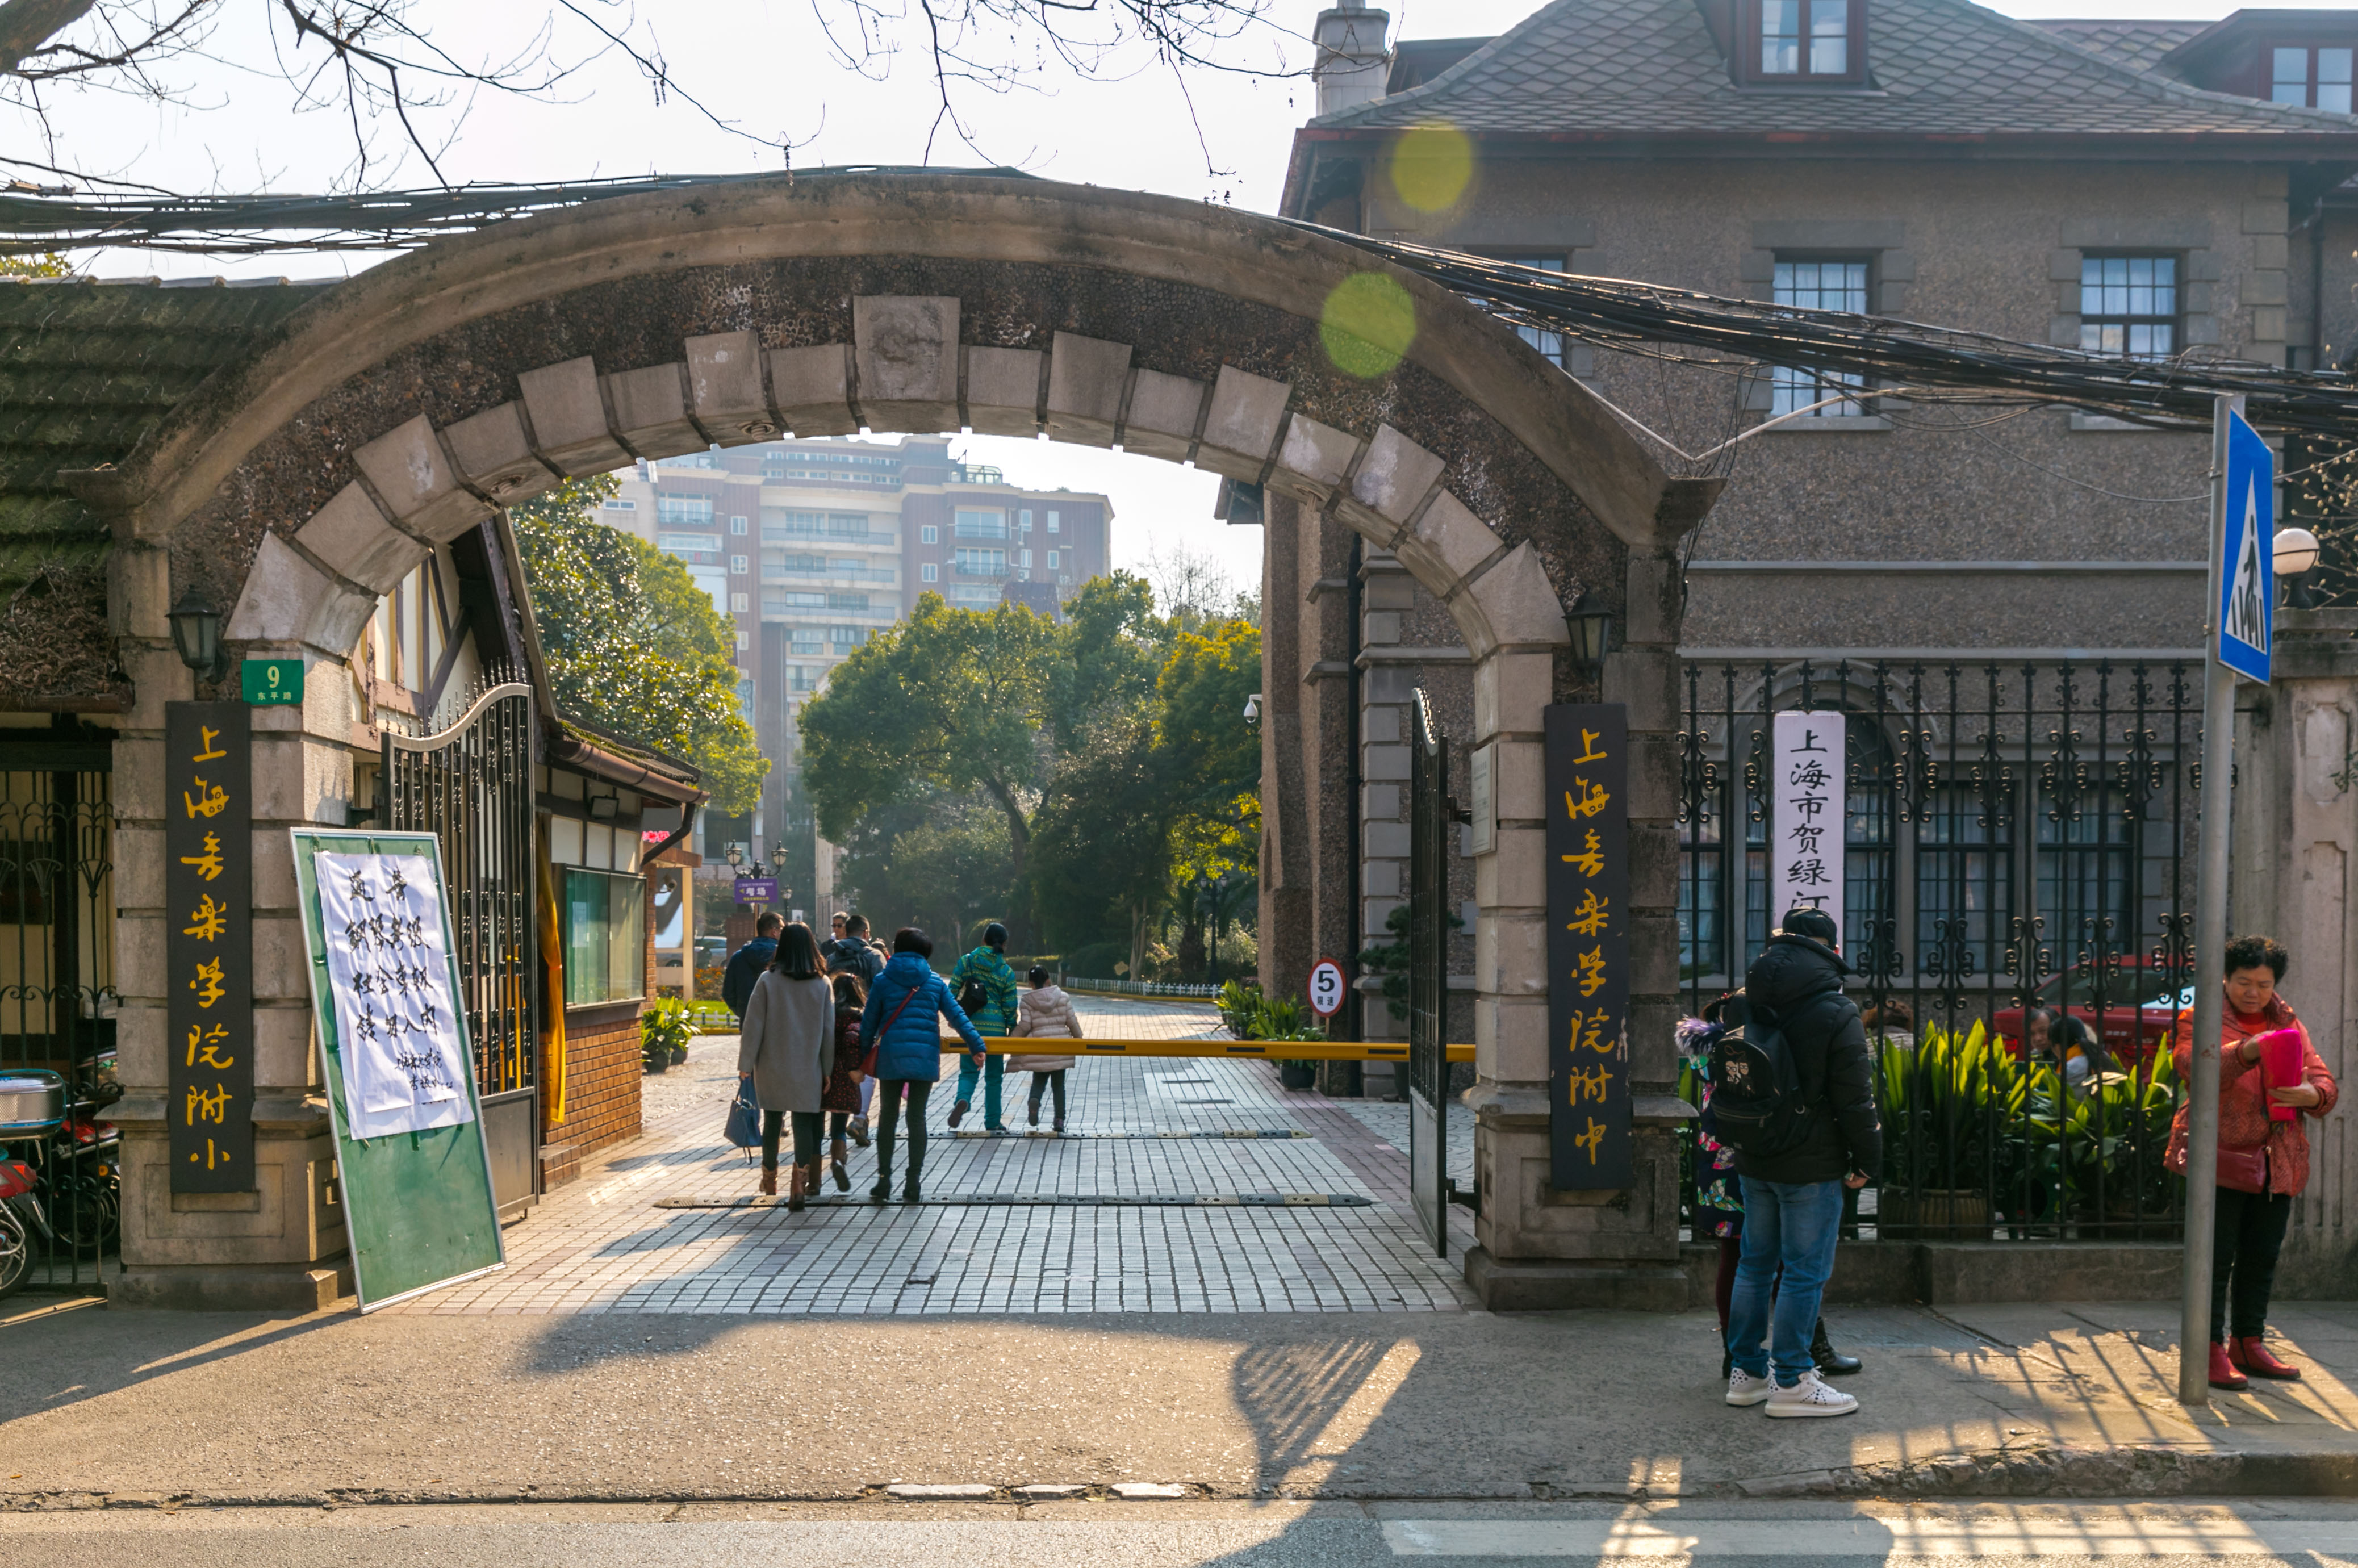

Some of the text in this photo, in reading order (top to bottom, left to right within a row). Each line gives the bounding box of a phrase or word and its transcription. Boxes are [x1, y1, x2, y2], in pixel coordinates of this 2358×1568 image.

[267, 665, 280, 689] 9
[258, 692, 291, 700] 东平路
[1318, 970, 1335, 992] 5
[1317, 996, 1334, 1006] 限速
